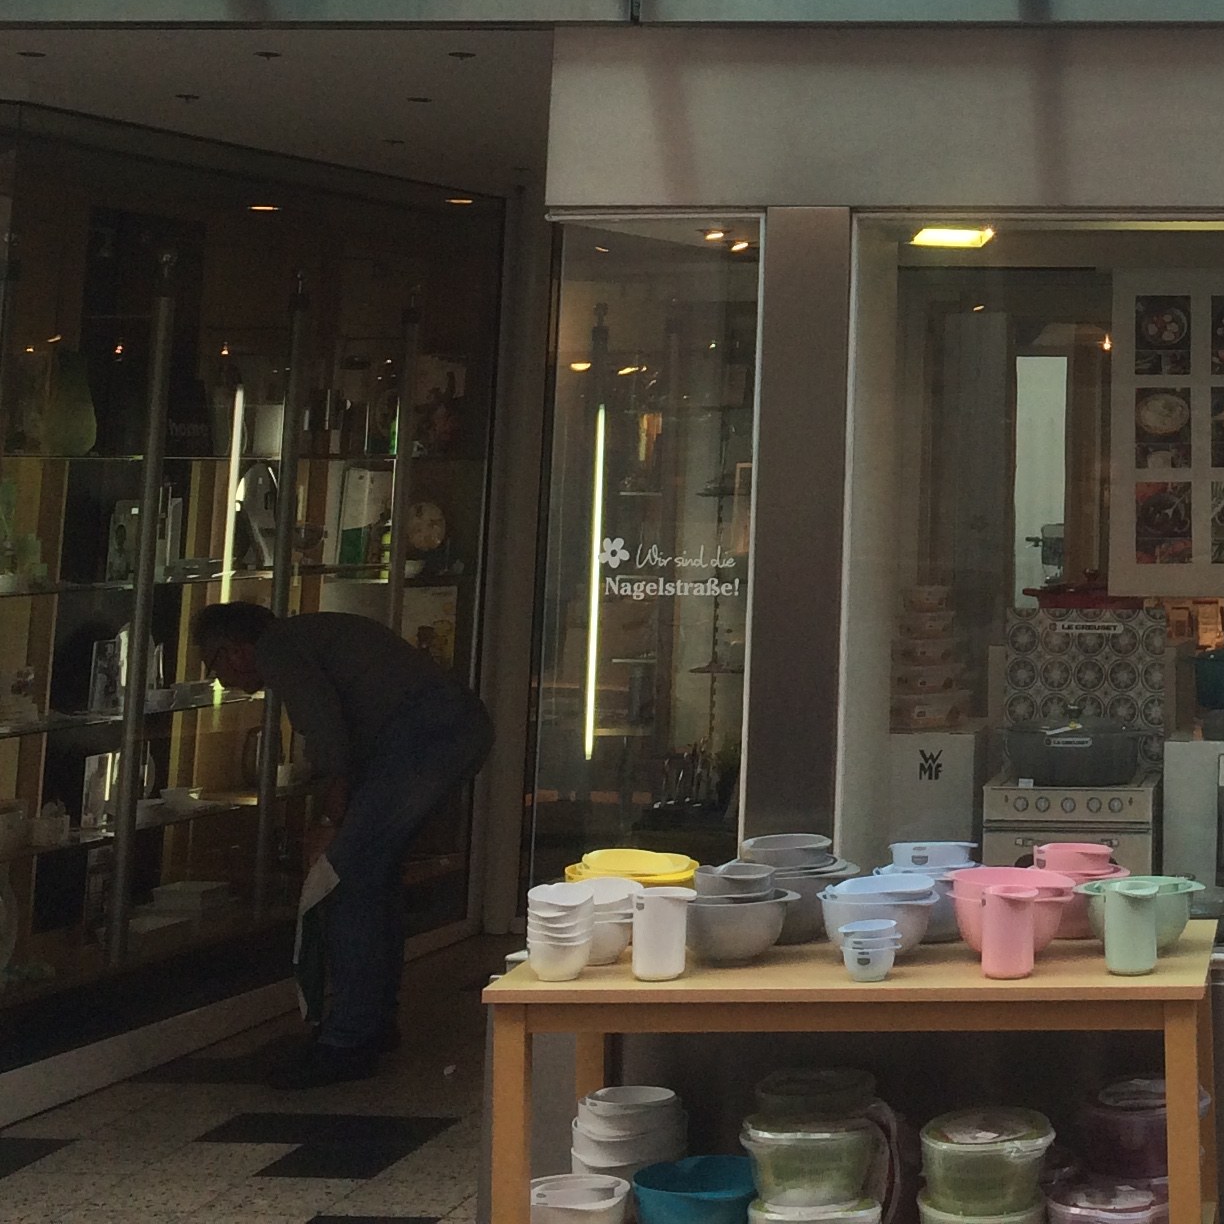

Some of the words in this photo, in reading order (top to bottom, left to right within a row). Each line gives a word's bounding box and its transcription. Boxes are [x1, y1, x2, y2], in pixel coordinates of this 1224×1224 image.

[636, 544, 672, 568] Wir
[674, 544, 708, 568] sind
[710, 545, 736, 568] die
[605, 577, 739, 601] Nagelstraße!
[1061, 623, 1074, 631] LE
